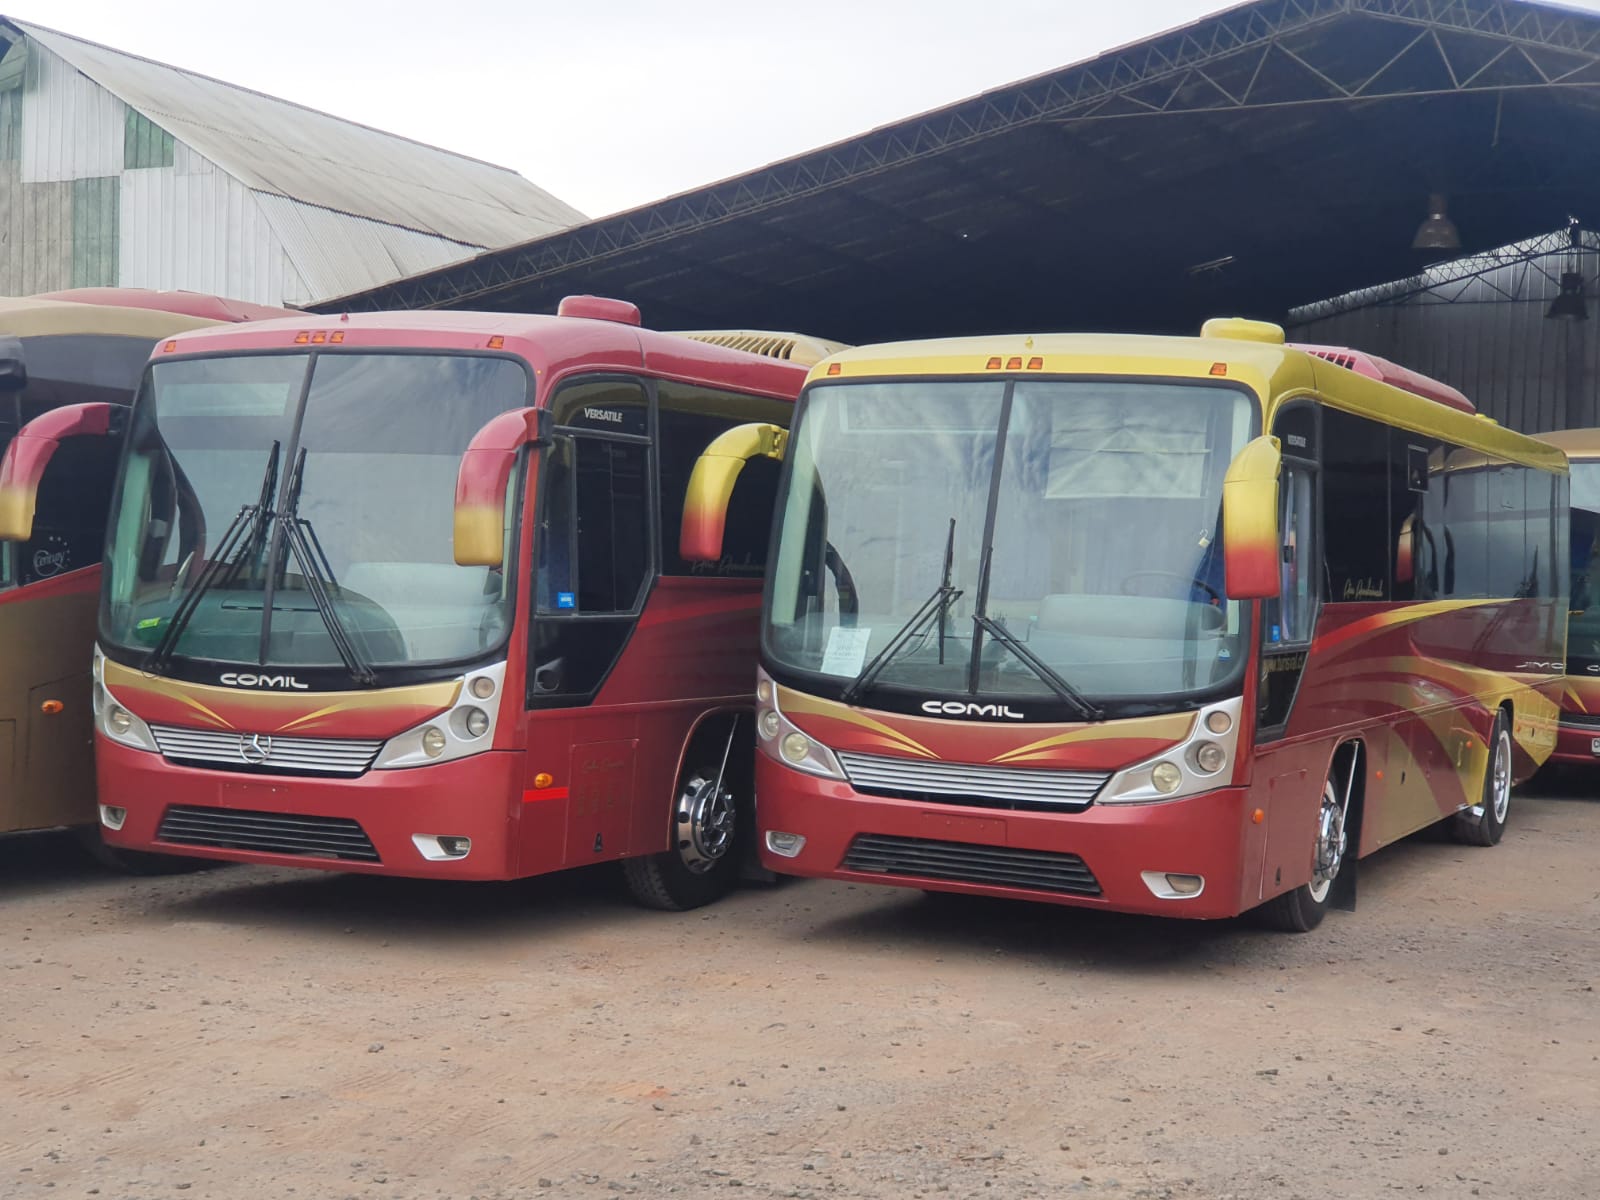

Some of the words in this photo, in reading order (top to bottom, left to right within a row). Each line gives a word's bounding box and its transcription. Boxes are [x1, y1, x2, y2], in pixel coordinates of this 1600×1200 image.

[584, 407, 623, 423] VERSATILE
[220, 673, 309, 689] COMIL
[921, 700, 1024, 719] COMIL
